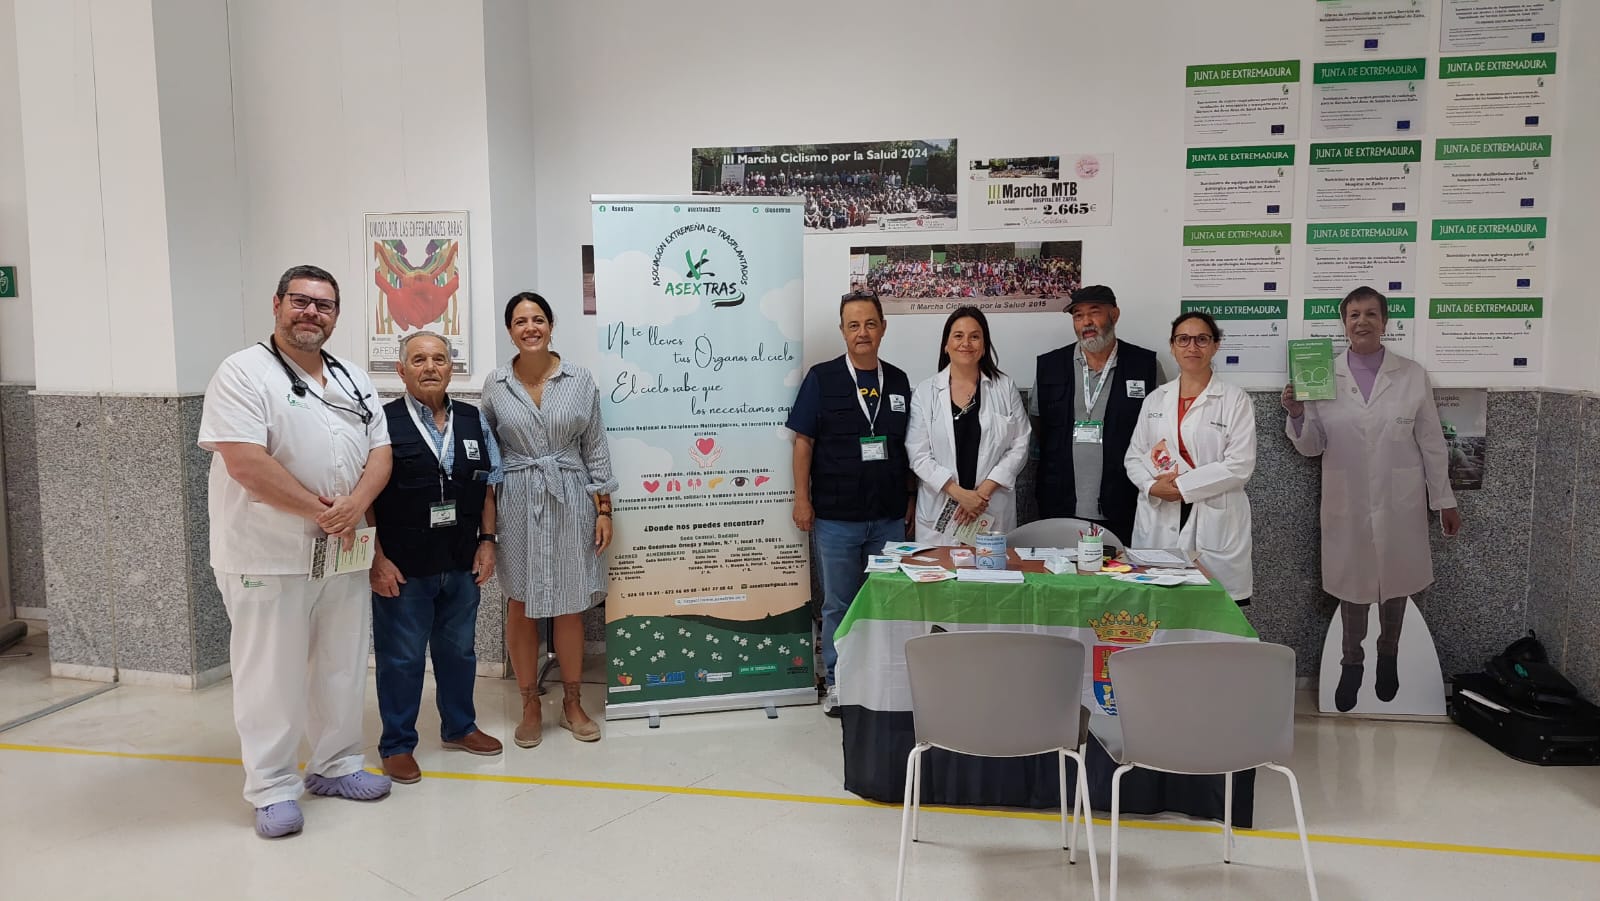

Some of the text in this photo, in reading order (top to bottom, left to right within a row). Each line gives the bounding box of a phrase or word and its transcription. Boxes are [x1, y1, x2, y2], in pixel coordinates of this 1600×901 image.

[1194, 66, 1292, 82] JUNTA DE EXTREMADURA
[1321, 64, 1418, 78] JUNTA DE EXTREMADURA
[1447, 60, 1547, 74] JUNTA DE EXTREMADURA
[1316, 146, 1415, 160] JUNTA DE EXTREMADURA
[1443, 142, 1544, 154] JUNTA DE EXTREMADURA
[724, 148, 928, 164] III Marcha Ciclismo por la Salud 2024
[1192, 154, 1218, 162] JUNTA
[1230, 151, 1289, 160] EXTREMADURA
[988, 181, 1078, 200] III Marcha MTB
[370, 220, 463, 238] UNIDOS POR LAS ENFERMEDADES RARAS
[1191, 231, 1216, 240] JUNTA
[1228, 230, 1284, 238] EXTREMADURA
[1313, 227, 1409, 240] JUNTA DE EXTREMADURA
[1440, 224, 1538, 235] JUNTA DE EXTREMADURA
[664, 222, 706, 244] EXTREMEÑA
[706, 225, 717, 234] DE
[718, 229, 748, 286] TRASPLANTADOS
[664, 282, 737, 296] ASEXTRAS
[980, 302, 992, 310] por
[1188, 305, 1281, 315] JUNTA DE EXTREMADURA
[1312, 306, 1336, 315] JUNTA
[1436, 303, 1534, 314] JUNTA DE EXTREMADURA
[608, 321, 630, 359] No
[648, 326, 684, 346] lleves
[380, 346, 399, 355] FEDE
[673, 351, 692, 364] tus
[750, 342, 763, 362] al
[767, 342, 795, 362] cielo
[611, 370, 723, 404] El cielo sabe que
[691, 396, 706, 416] los
[709, 402, 774, 414] necesitamos
[644, 524, 673, 532] ¿Donde
[692, 522, 721, 530] puedes
[724, 518, 764, 528] encontrar?
